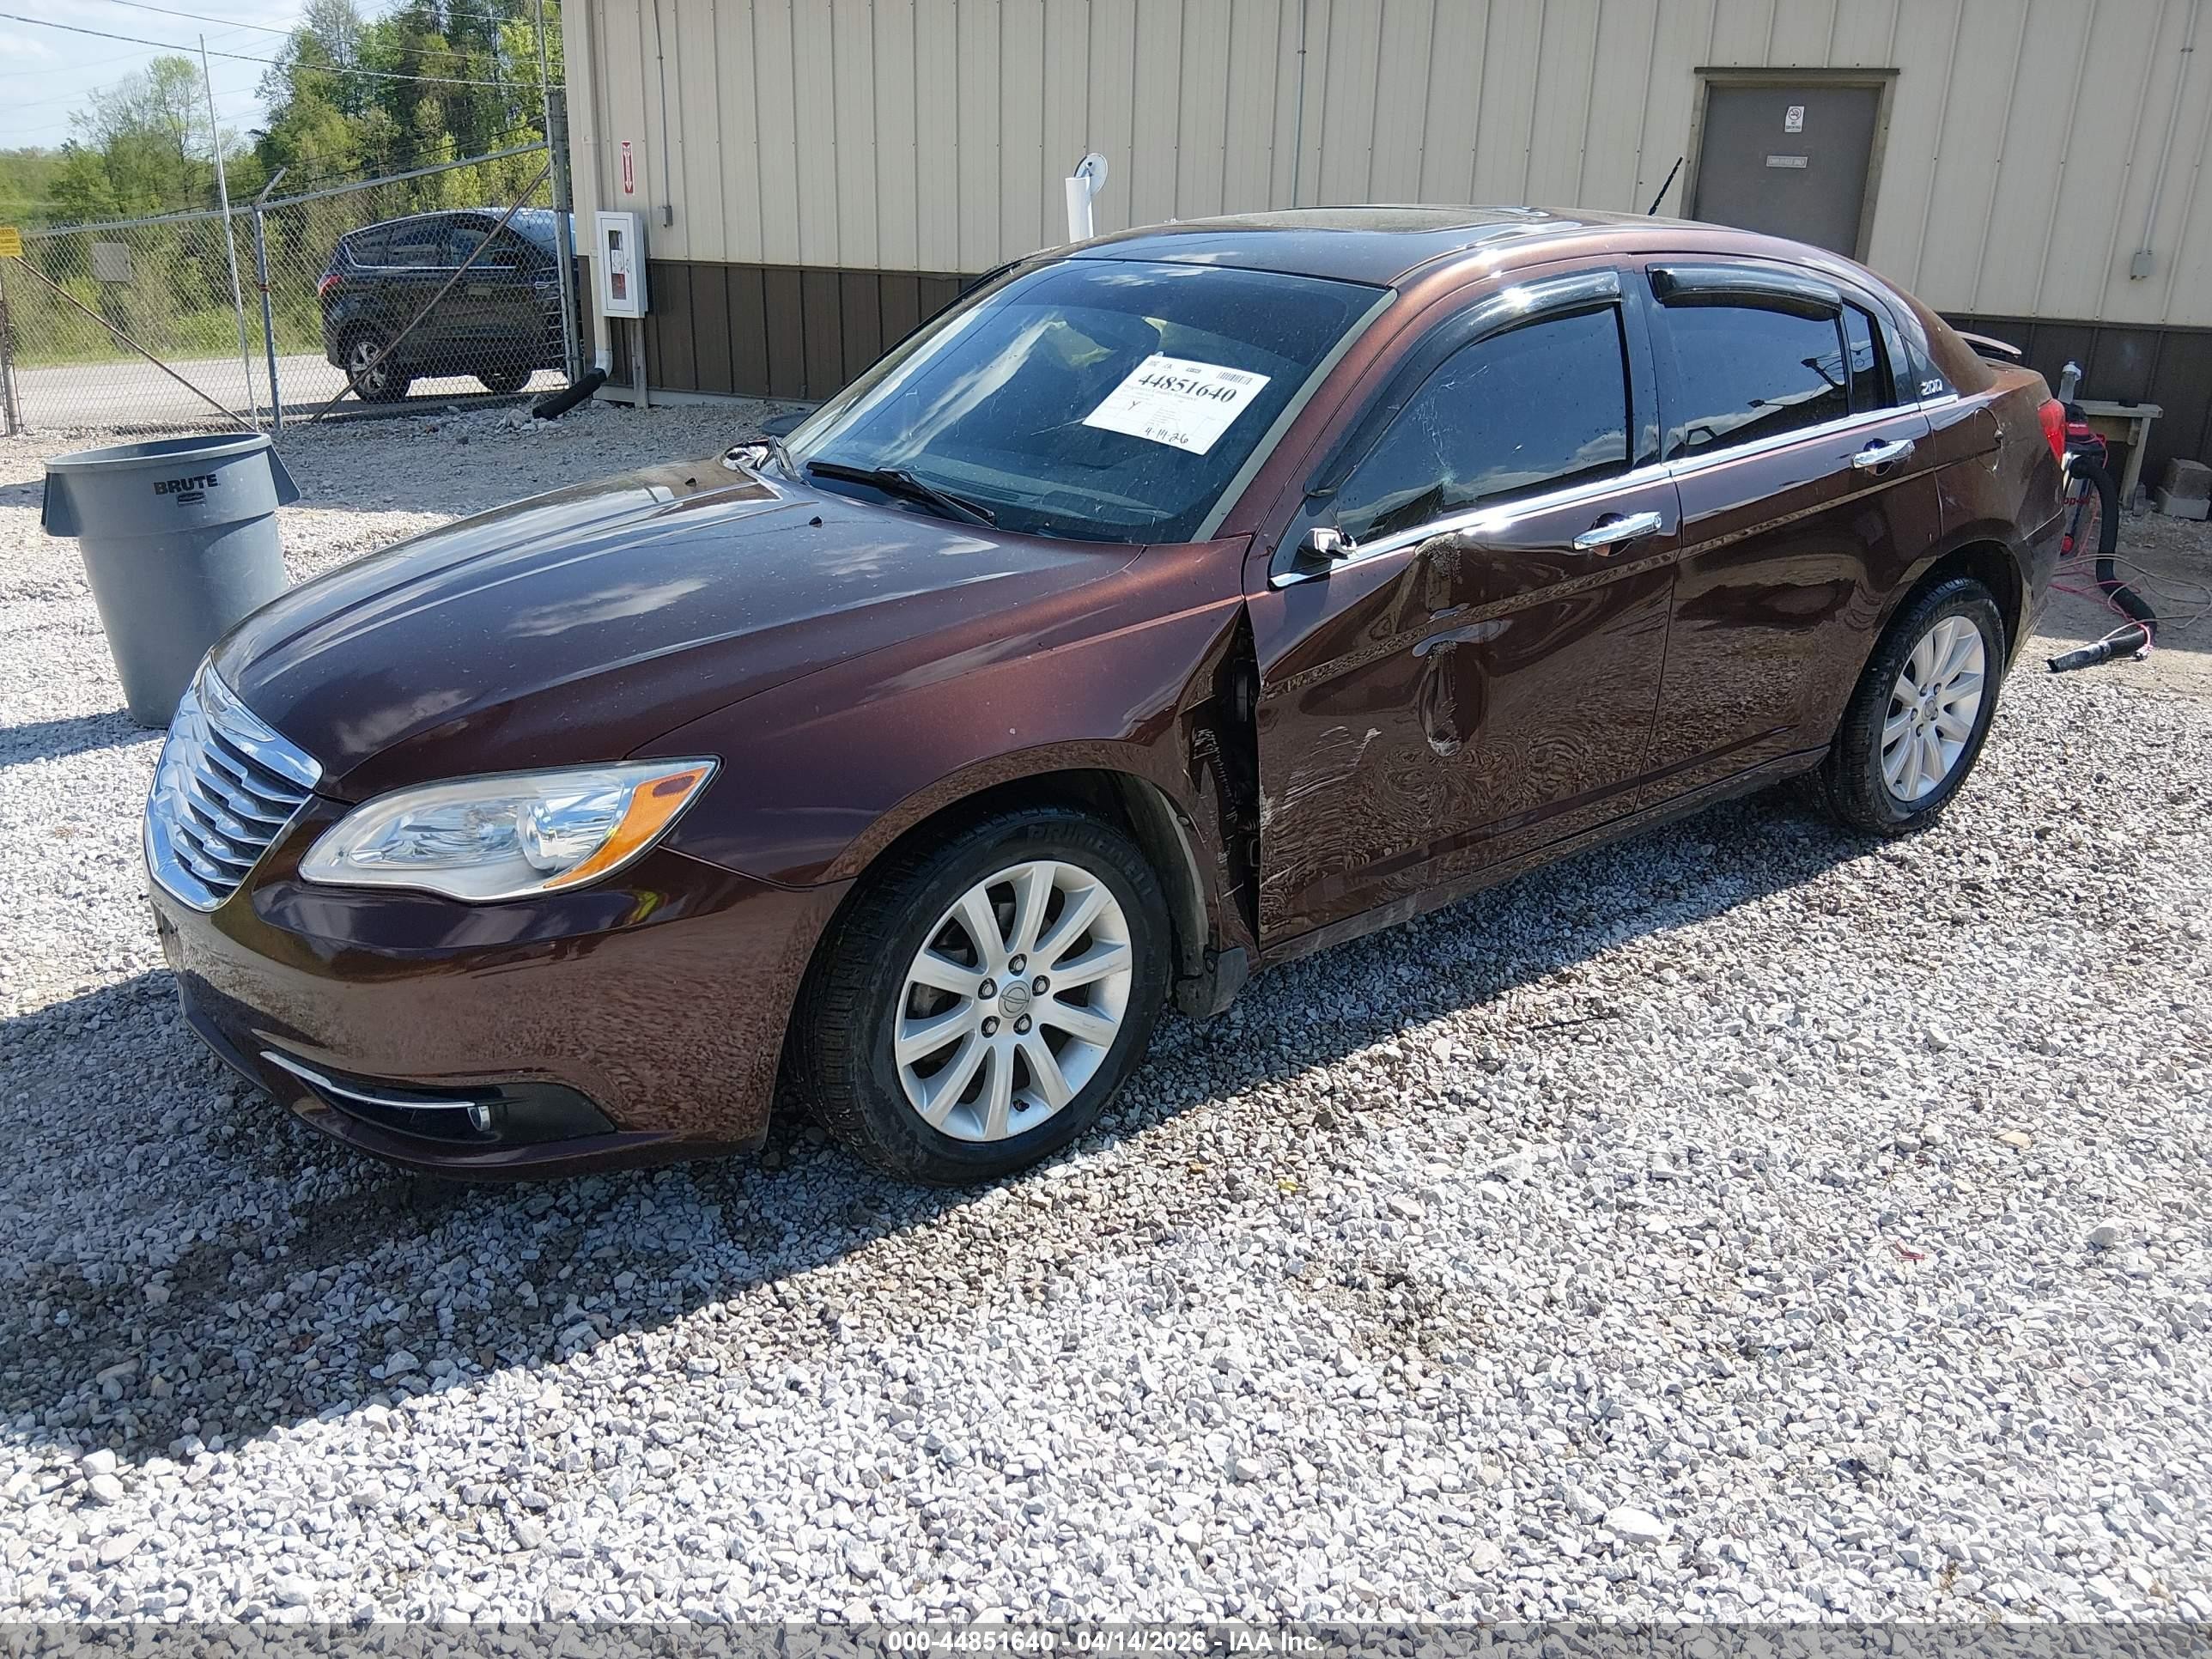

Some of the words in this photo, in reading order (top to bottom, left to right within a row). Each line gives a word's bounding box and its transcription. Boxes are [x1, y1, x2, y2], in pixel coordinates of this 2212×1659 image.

[1138, 373, 1237, 404] 44851640
[1920, 378, 1943, 397] 200
[154, 473, 220, 495] BRUTE
